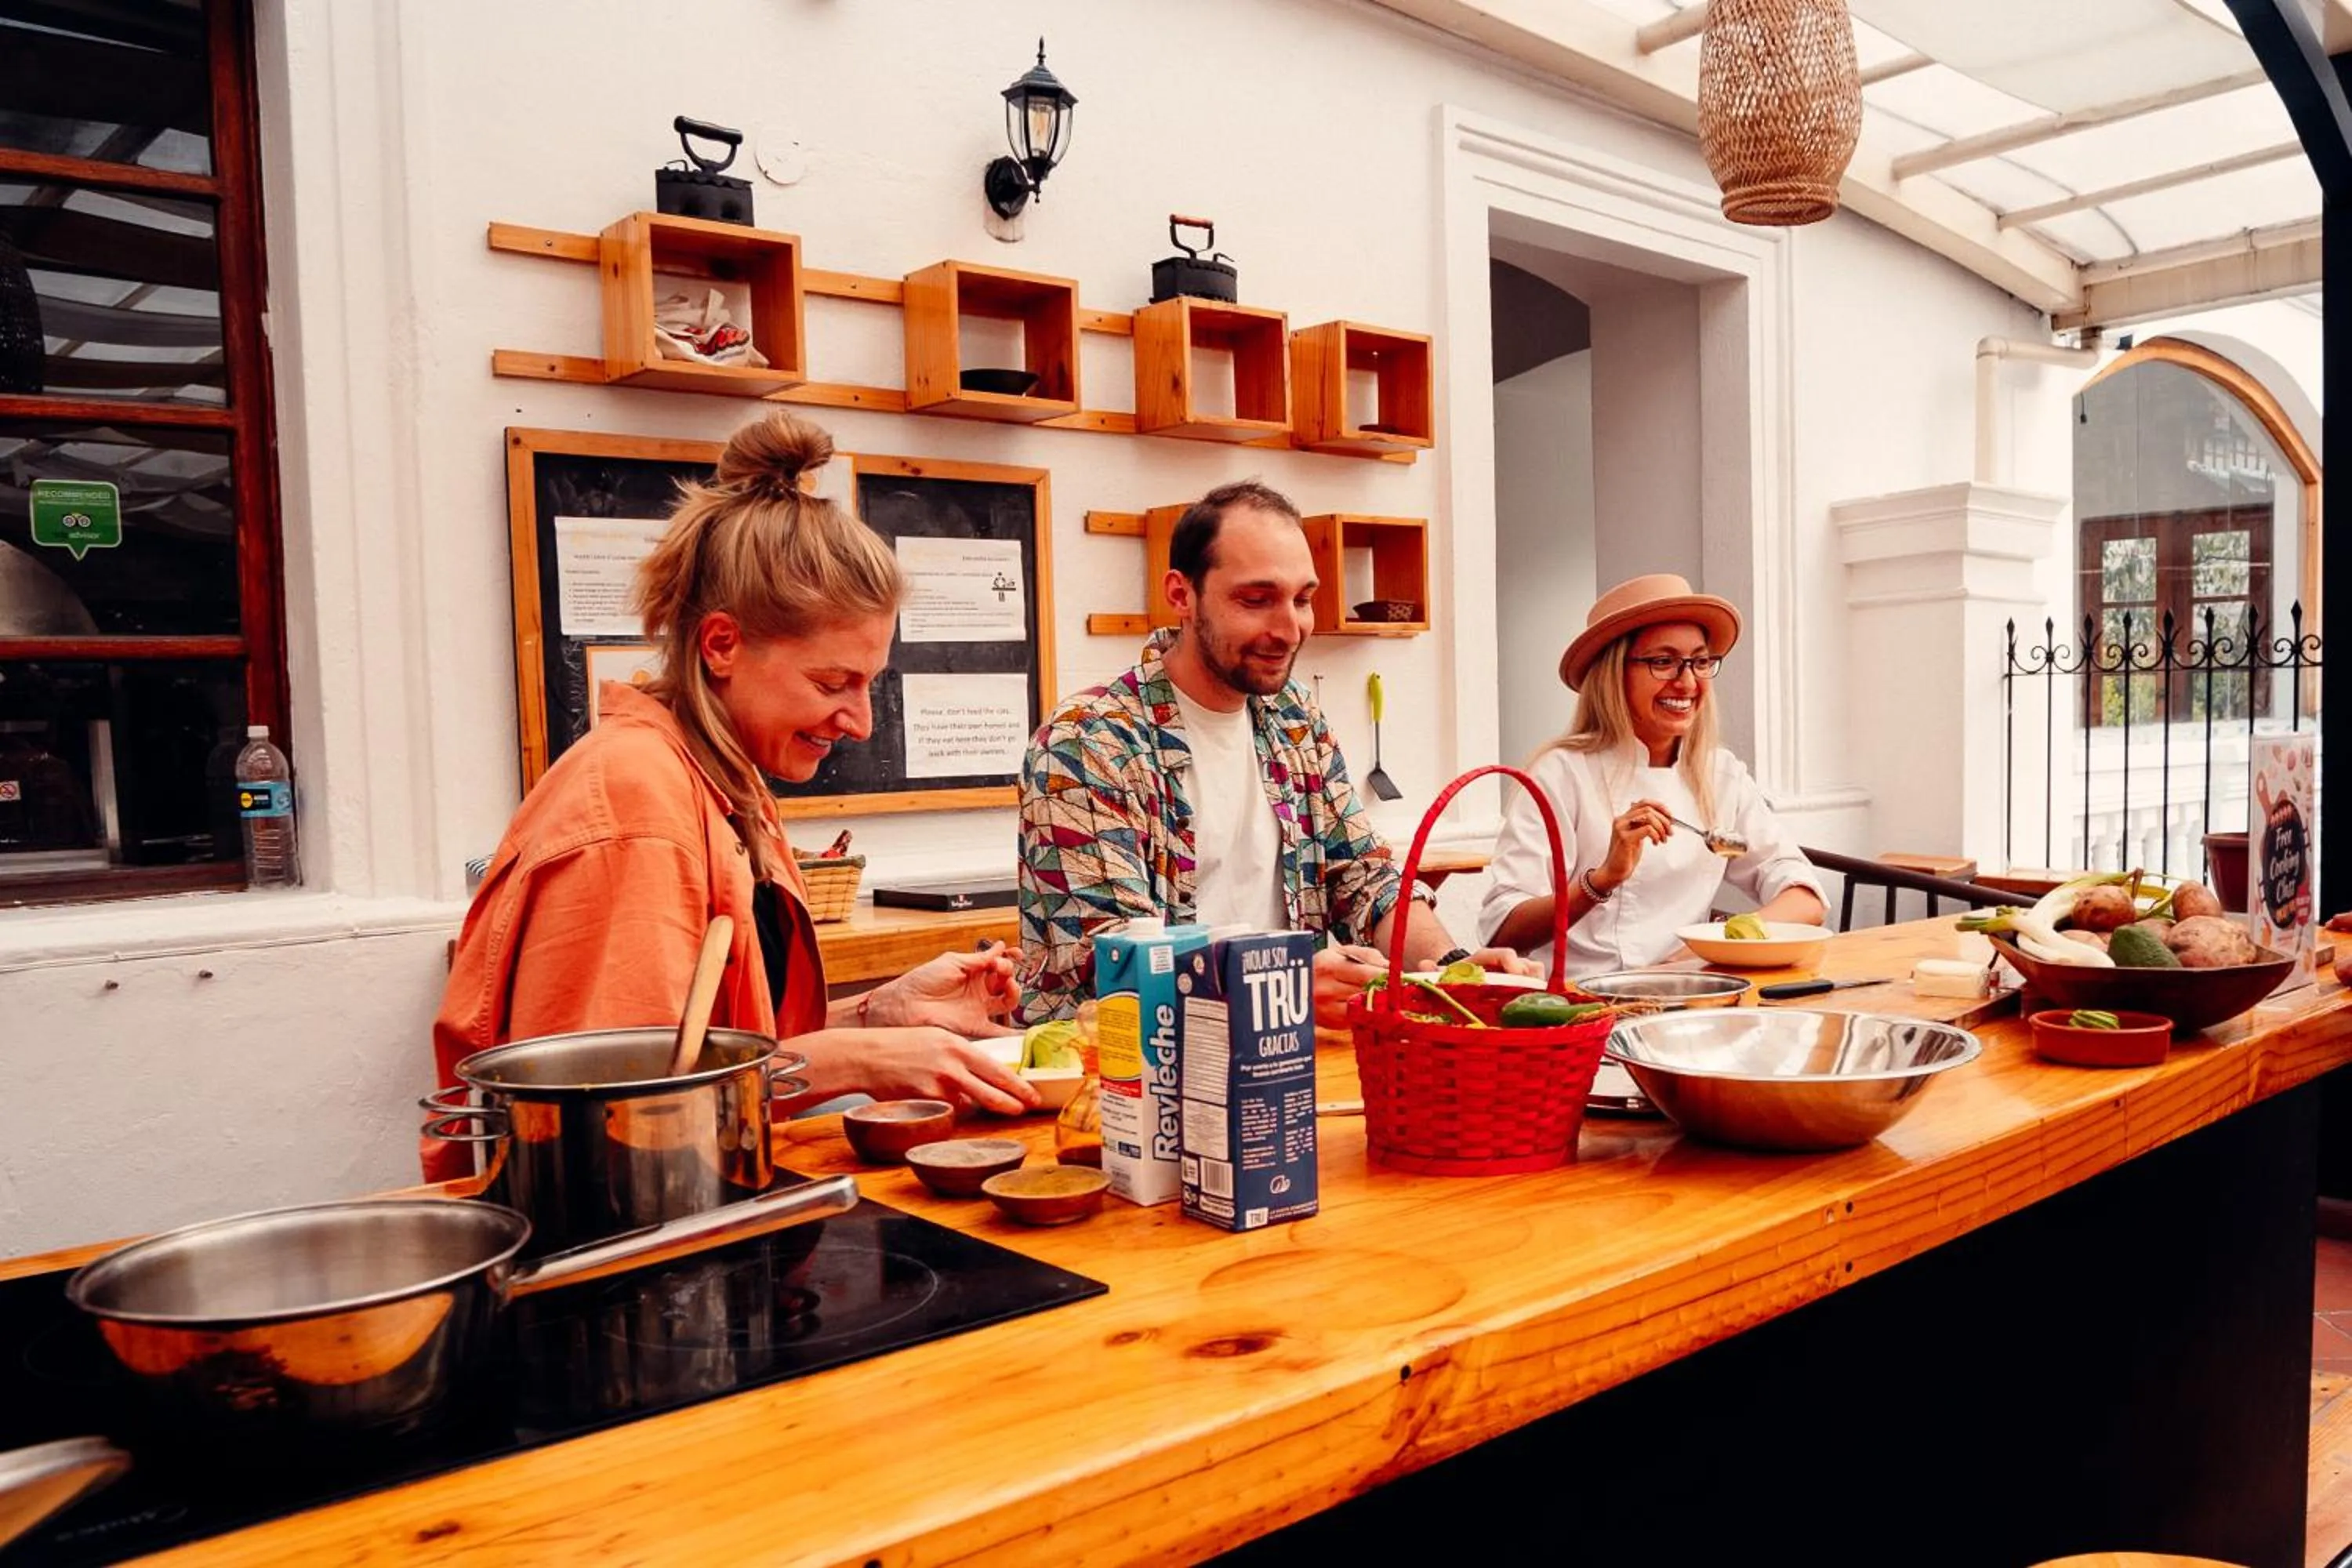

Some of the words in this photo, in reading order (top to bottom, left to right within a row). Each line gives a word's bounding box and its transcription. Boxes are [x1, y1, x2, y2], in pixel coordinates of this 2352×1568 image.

[1272, 946, 1288, 967] SOY
[1243, 959, 1308, 1032] TRÜ
[1258, 1031, 1300, 1058] GRACIAS
[1149, 1004, 1181, 1162] Revleche
